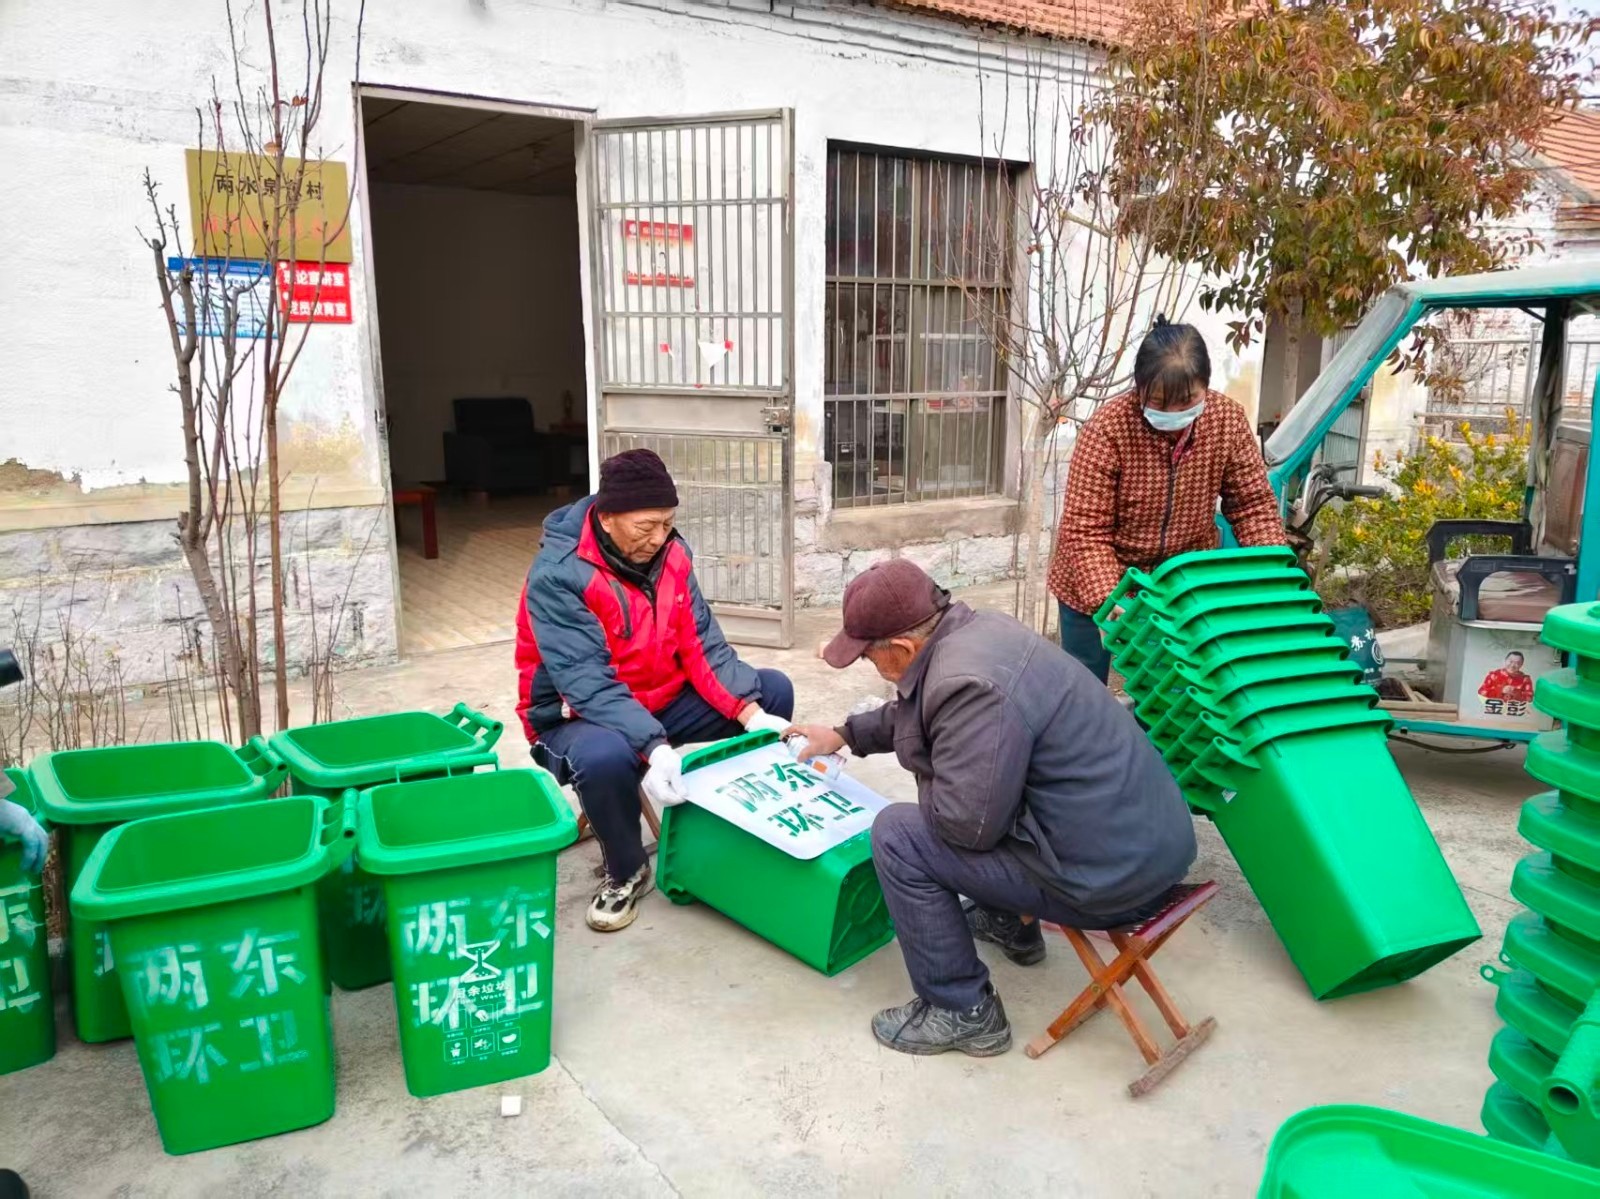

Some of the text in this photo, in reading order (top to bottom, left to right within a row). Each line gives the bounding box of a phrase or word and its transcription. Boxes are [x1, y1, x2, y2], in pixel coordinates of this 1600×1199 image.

[215, 174, 322, 201] 两水泉村
[1484, 699, 1527, 717] 金彭
[715, 762, 824, 813] 两东
[767, 790, 865, 838] 环卫
[398, 887, 551, 961] 两东
[125, 928, 307, 1010] 两东
[409, 963, 545, 1031] 环卫
[149, 1010, 309, 1084] 环卫
